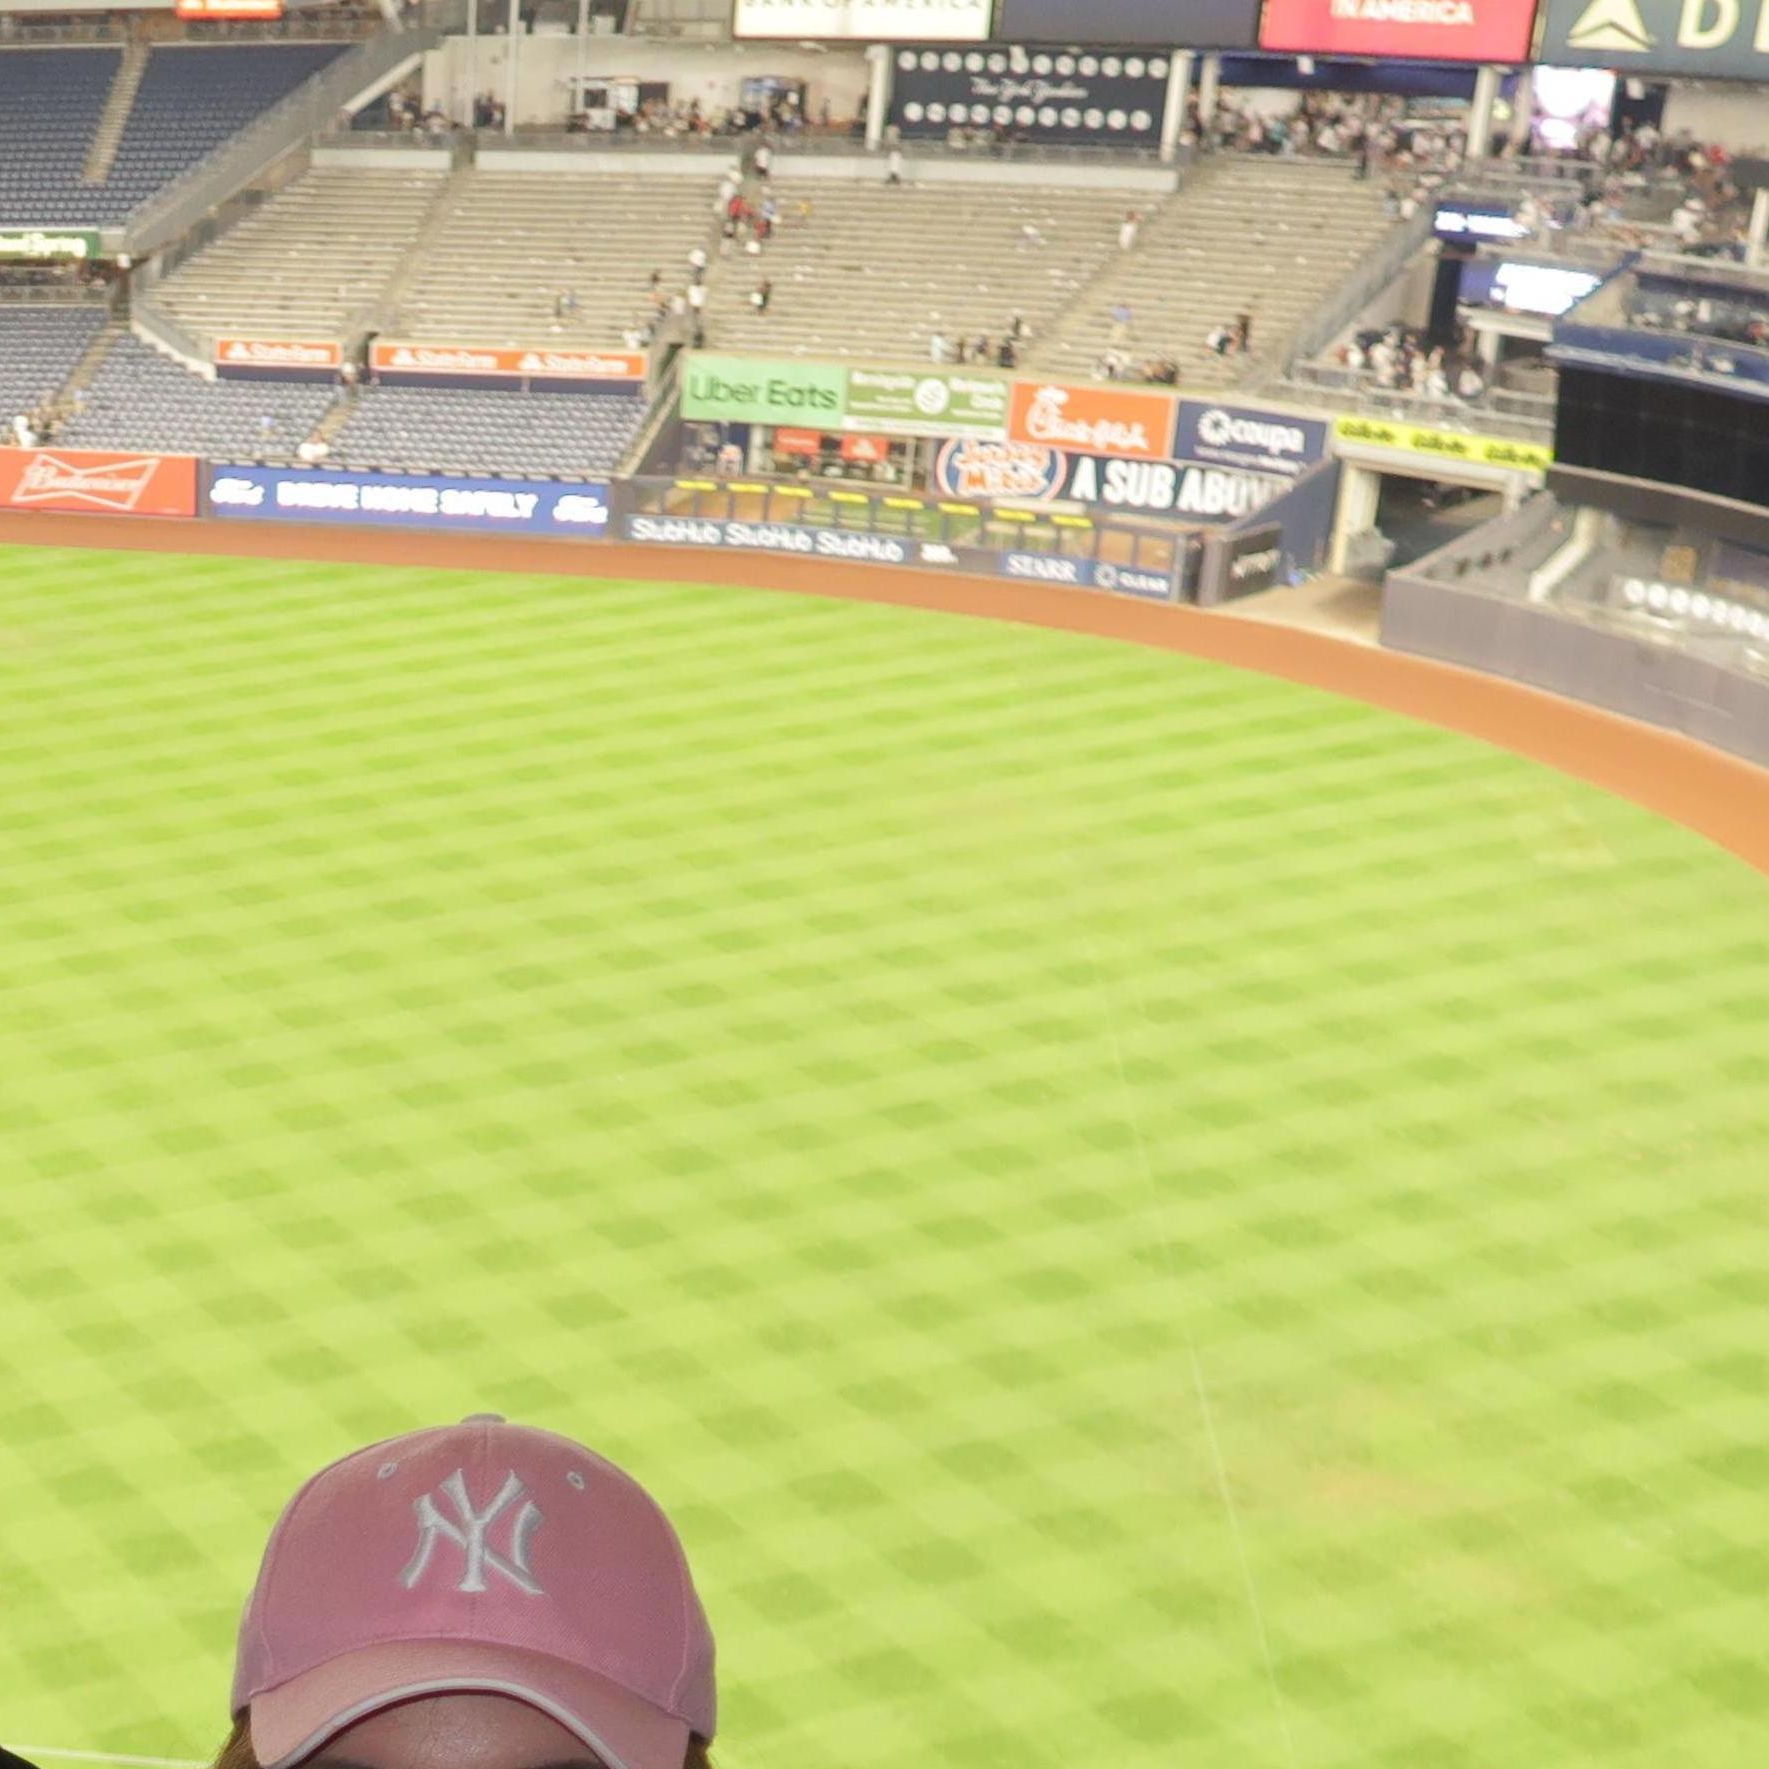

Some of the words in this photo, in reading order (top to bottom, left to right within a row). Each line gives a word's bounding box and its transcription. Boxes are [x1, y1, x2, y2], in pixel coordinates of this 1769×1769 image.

[1363, 0, 1476, 26] AMERICA
[689, 371, 761, 402] Uber
[767, 379, 839, 409] Eats
[1070, 456, 1098, 501] A
[1102, 458, 1176, 510] SUB
[399, 1467, 546, 1596] NY
